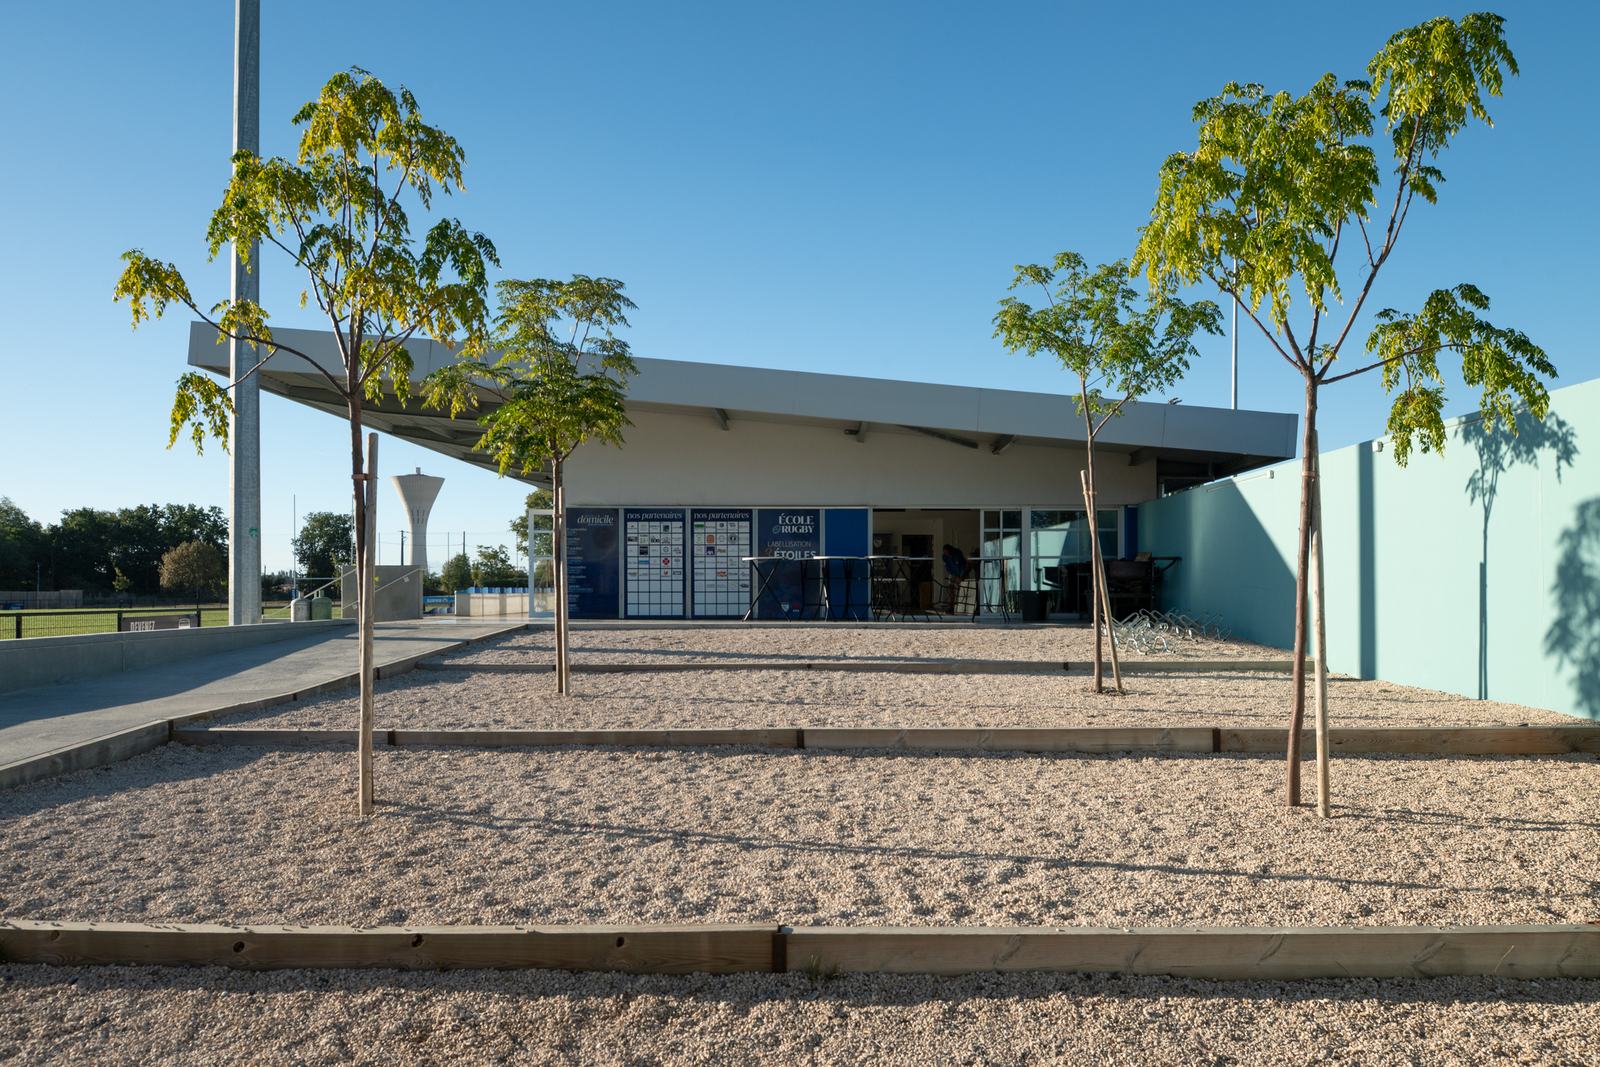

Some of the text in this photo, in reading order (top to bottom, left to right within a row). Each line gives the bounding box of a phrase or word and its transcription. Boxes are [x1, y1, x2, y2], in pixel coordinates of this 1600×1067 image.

[577, 514, 614, 524] domicile
[641, 511, 682, 520] partenaires
[708, 511, 750, 520] partenaires
[778, 512, 815, 525] ÉCOLE
[781, 525, 814, 533] RUGBY
